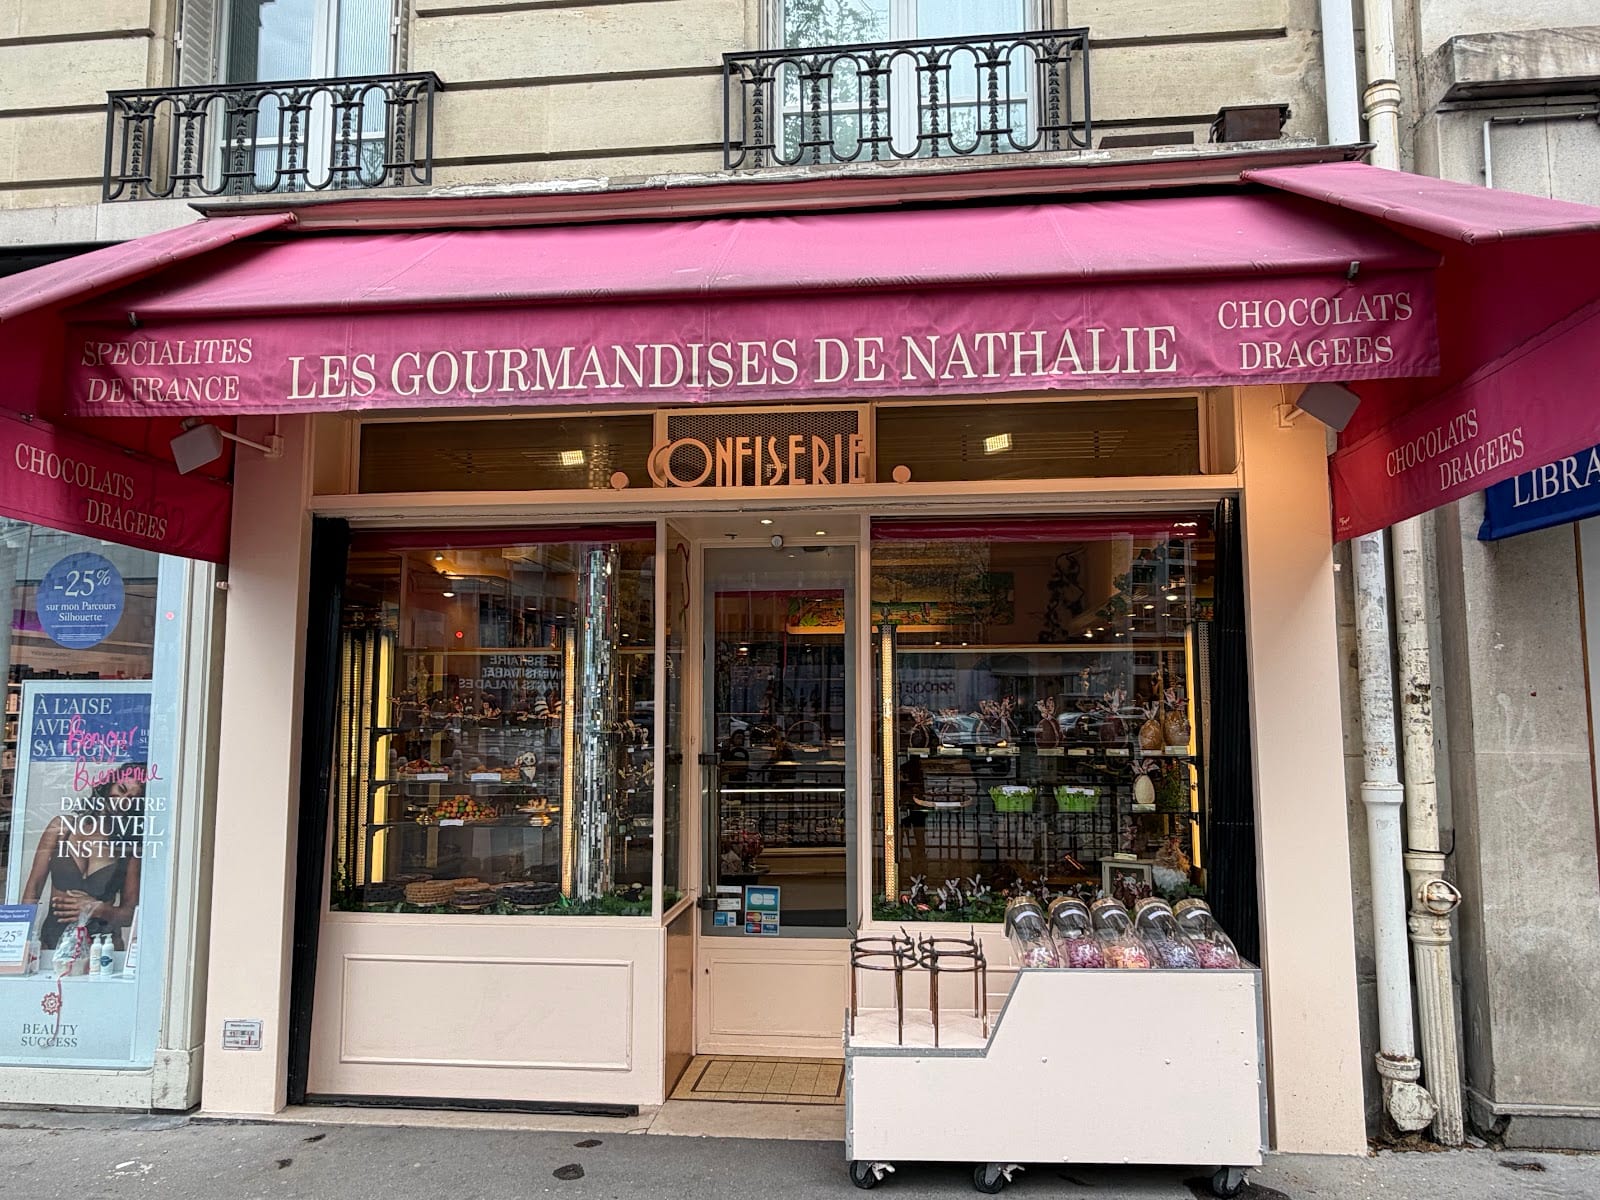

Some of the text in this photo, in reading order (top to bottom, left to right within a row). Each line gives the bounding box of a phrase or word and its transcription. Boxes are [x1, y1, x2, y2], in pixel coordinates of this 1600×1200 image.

[1218, 292, 1413, 330] CHOCOLATS
[82, 337, 253, 367] SPECIALITES
[287, 326, 1178, 400] LES GOURMANDISES DE NATHALIE
[1240, 335, 1394, 370] DRAGEES
[87, 376, 240, 404] DE FRANCE
[1386, 408, 1479, 478] CHOCOLATS
[15, 442, 135, 500] CHOCOLATS
[647, 433, 867, 488] CONFISERIE
[1439, 427, 1524, 491] DRAGEES
[1513, 447, 1600, 508] LIBRA
[85, 498, 168, 541] DRAGEES
[54, 569, 111, 598] -25%
[45, 601, 116, 611] sur mon Parcours
[58, 612, 102, 621] Silhouette
[35, 694, 112, 715] À L'AISE
[33, 719, 86, 736] AVEC
[32, 740, 57, 757] SA
[60, 797, 167, 812] DANS VOTRE
[58, 815, 165, 837] NOUVEL
[57, 840, 164, 859] INSTITUT
[20, 1036, 79, 1049] SUCCESS
[22, 1023, 79, 1036] BEAUTY
